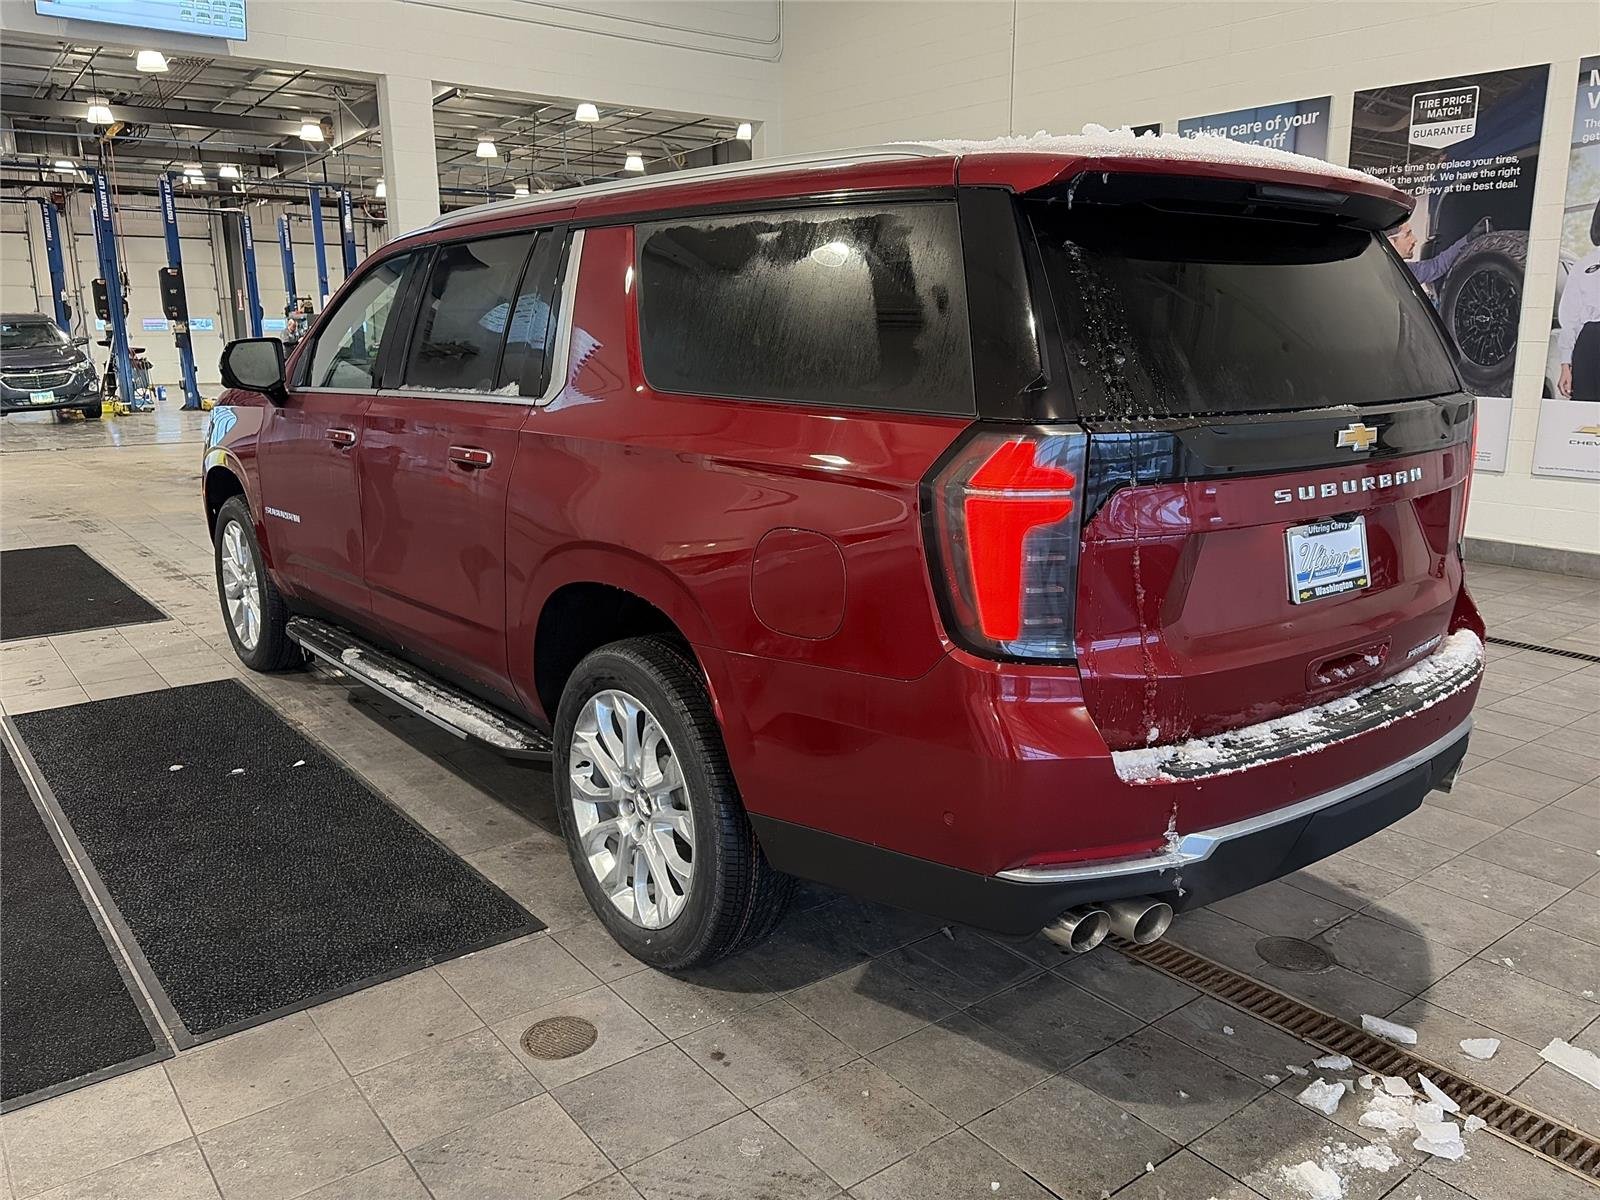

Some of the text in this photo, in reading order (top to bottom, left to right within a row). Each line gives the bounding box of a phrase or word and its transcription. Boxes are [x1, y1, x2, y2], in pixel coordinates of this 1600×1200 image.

[1419, 94, 1473, 109] TIRE PRICE
[1427, 106, 1462, 118] MATCH
[1230, 121, 1262, 136] care
[1265, 114, 1282, 131] of
[1284, 112, 1320, 132] your
[1413, 123, 1473, 139] GUARANTEE
[1263, 132, 1286, 148] off
[1363, 165, 1388, 176] When
[1404, 163, 1424, 172] time
[1426, 162, 1436, 170] to
[1437, 159, 1471, 170] replace
[1472, 157, 1494, 169] your
[1495, 154, 1520, 165] tires,
[1397, 174, 1412, 184] the
[1413, 173, 1438, 183] work.
[1440, 171, 1455, 181] We
[1456, 171, 1478, 180] have
[1480, 168, 1496, 178] the
[1497, 166, 1521, 178] right
[1415, 186, 1443, 196] Chevy
[1444, 184, 1454, 193] at
[1455, 182, 1471, 192] the
[1472, 180, 1494, 191] best
[1495, 178, 1519, 189] deal.
[100, 191, 110, 218] ROTARY
[165, 194, 174, 220] ROTARY
[1274, 467, 1422, 504] SUBURBAN
[1308, 521, 1348, 534] Uftring Chevy
[1315, 580, 1354, 596] Washington
